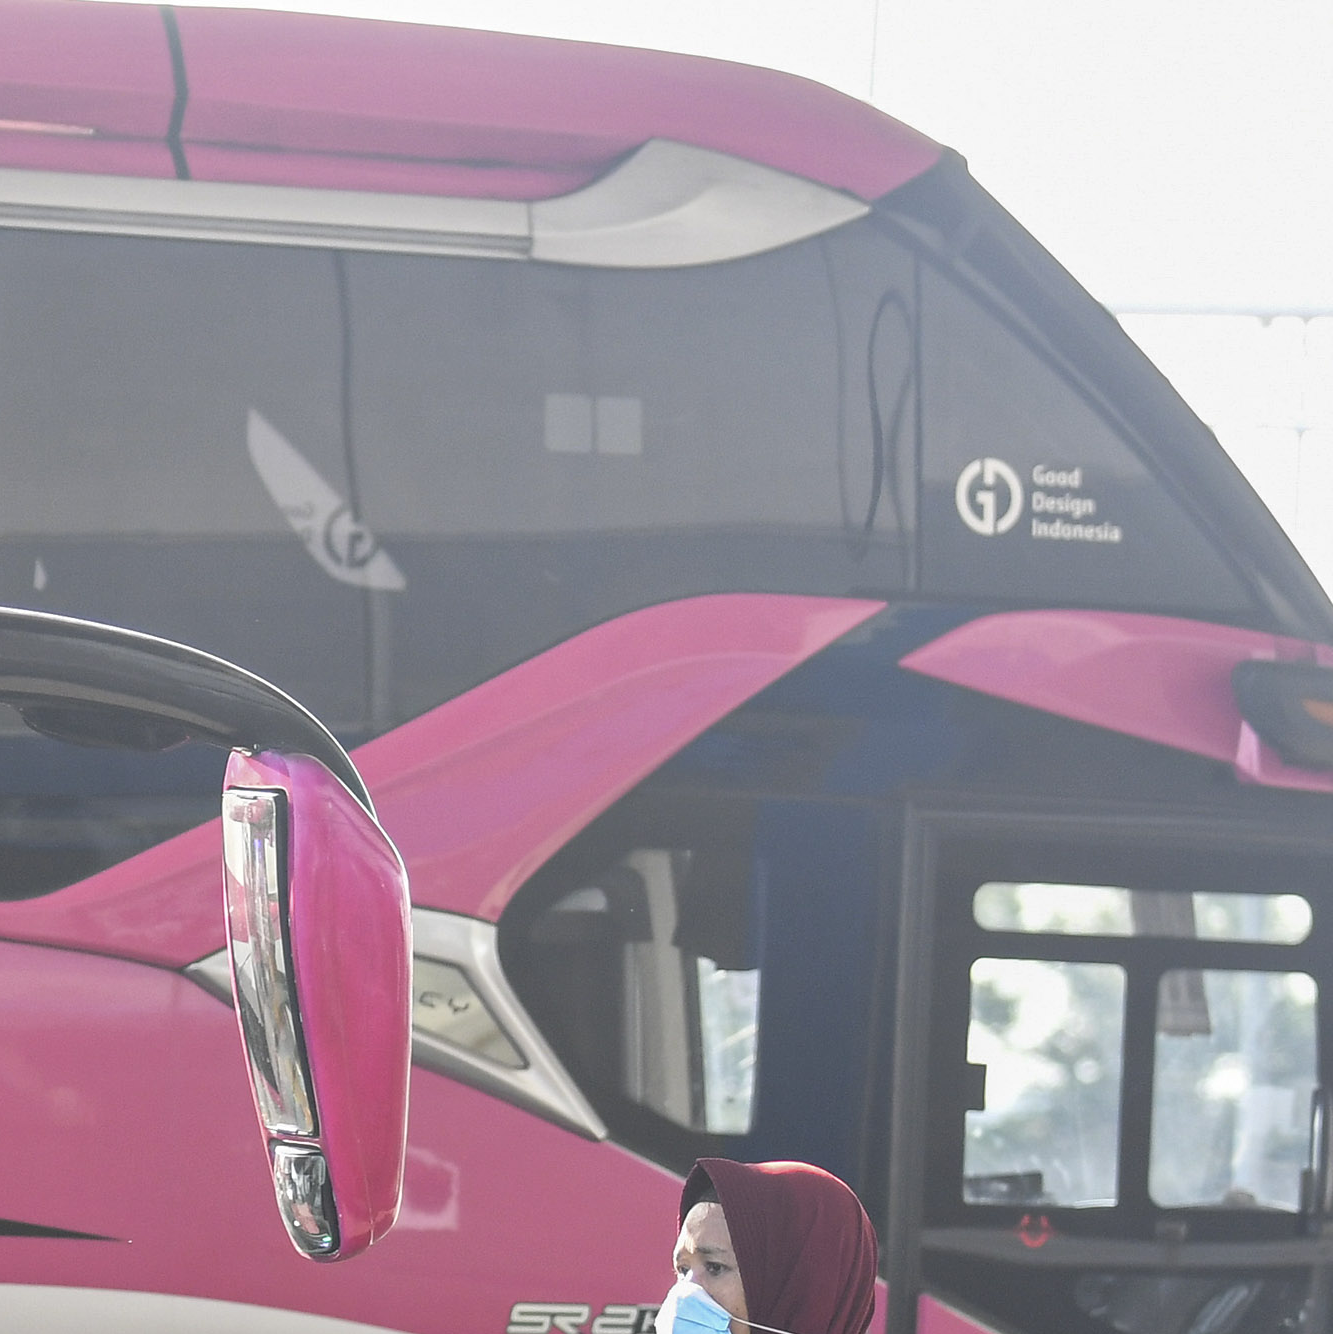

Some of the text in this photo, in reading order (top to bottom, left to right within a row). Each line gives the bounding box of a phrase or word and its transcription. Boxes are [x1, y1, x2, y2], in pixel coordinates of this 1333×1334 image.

[1033, 464, 1082, 488] Good
[1032, 491, 1096, 518] Design
[1032, 519, 1123, 543] Indonesia
